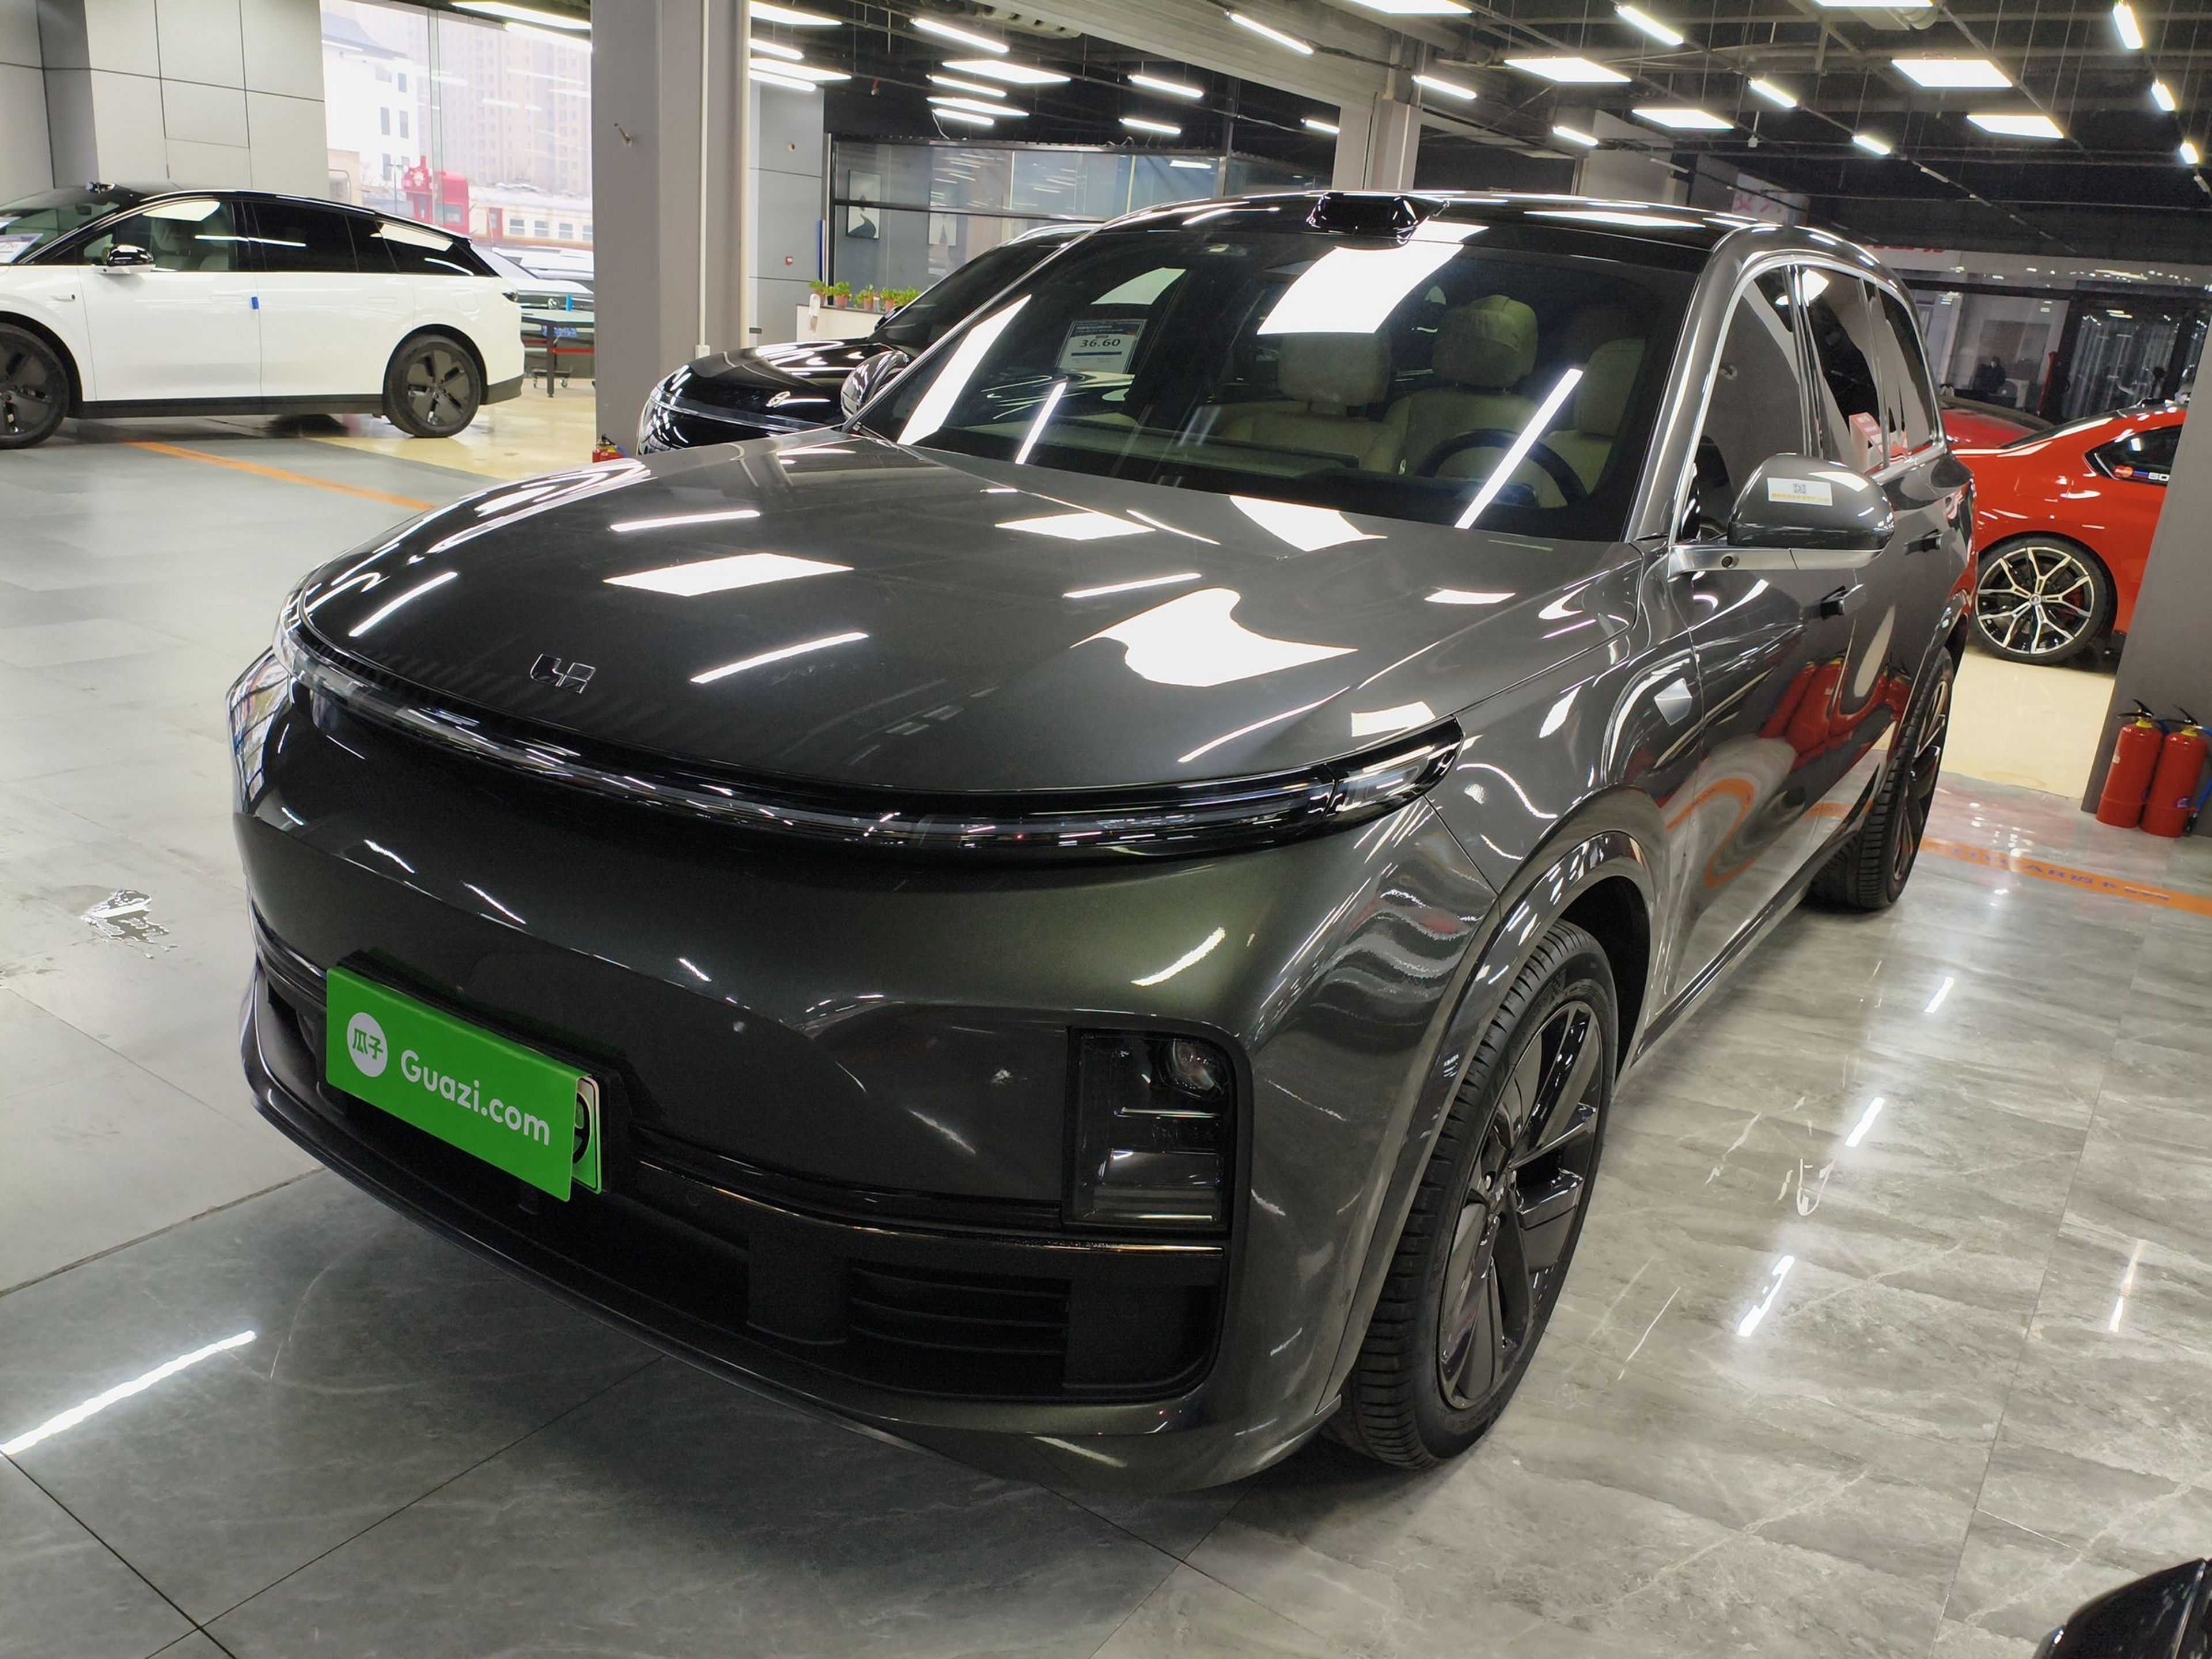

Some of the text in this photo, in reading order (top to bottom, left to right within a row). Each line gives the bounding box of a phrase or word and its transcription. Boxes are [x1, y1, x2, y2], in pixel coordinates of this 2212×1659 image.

[1079, 338, 1121, 348] 36.60
[352, 1028, 384, 1060] 瓜子
[400, 1050, 550, 1146] Guazi.com
